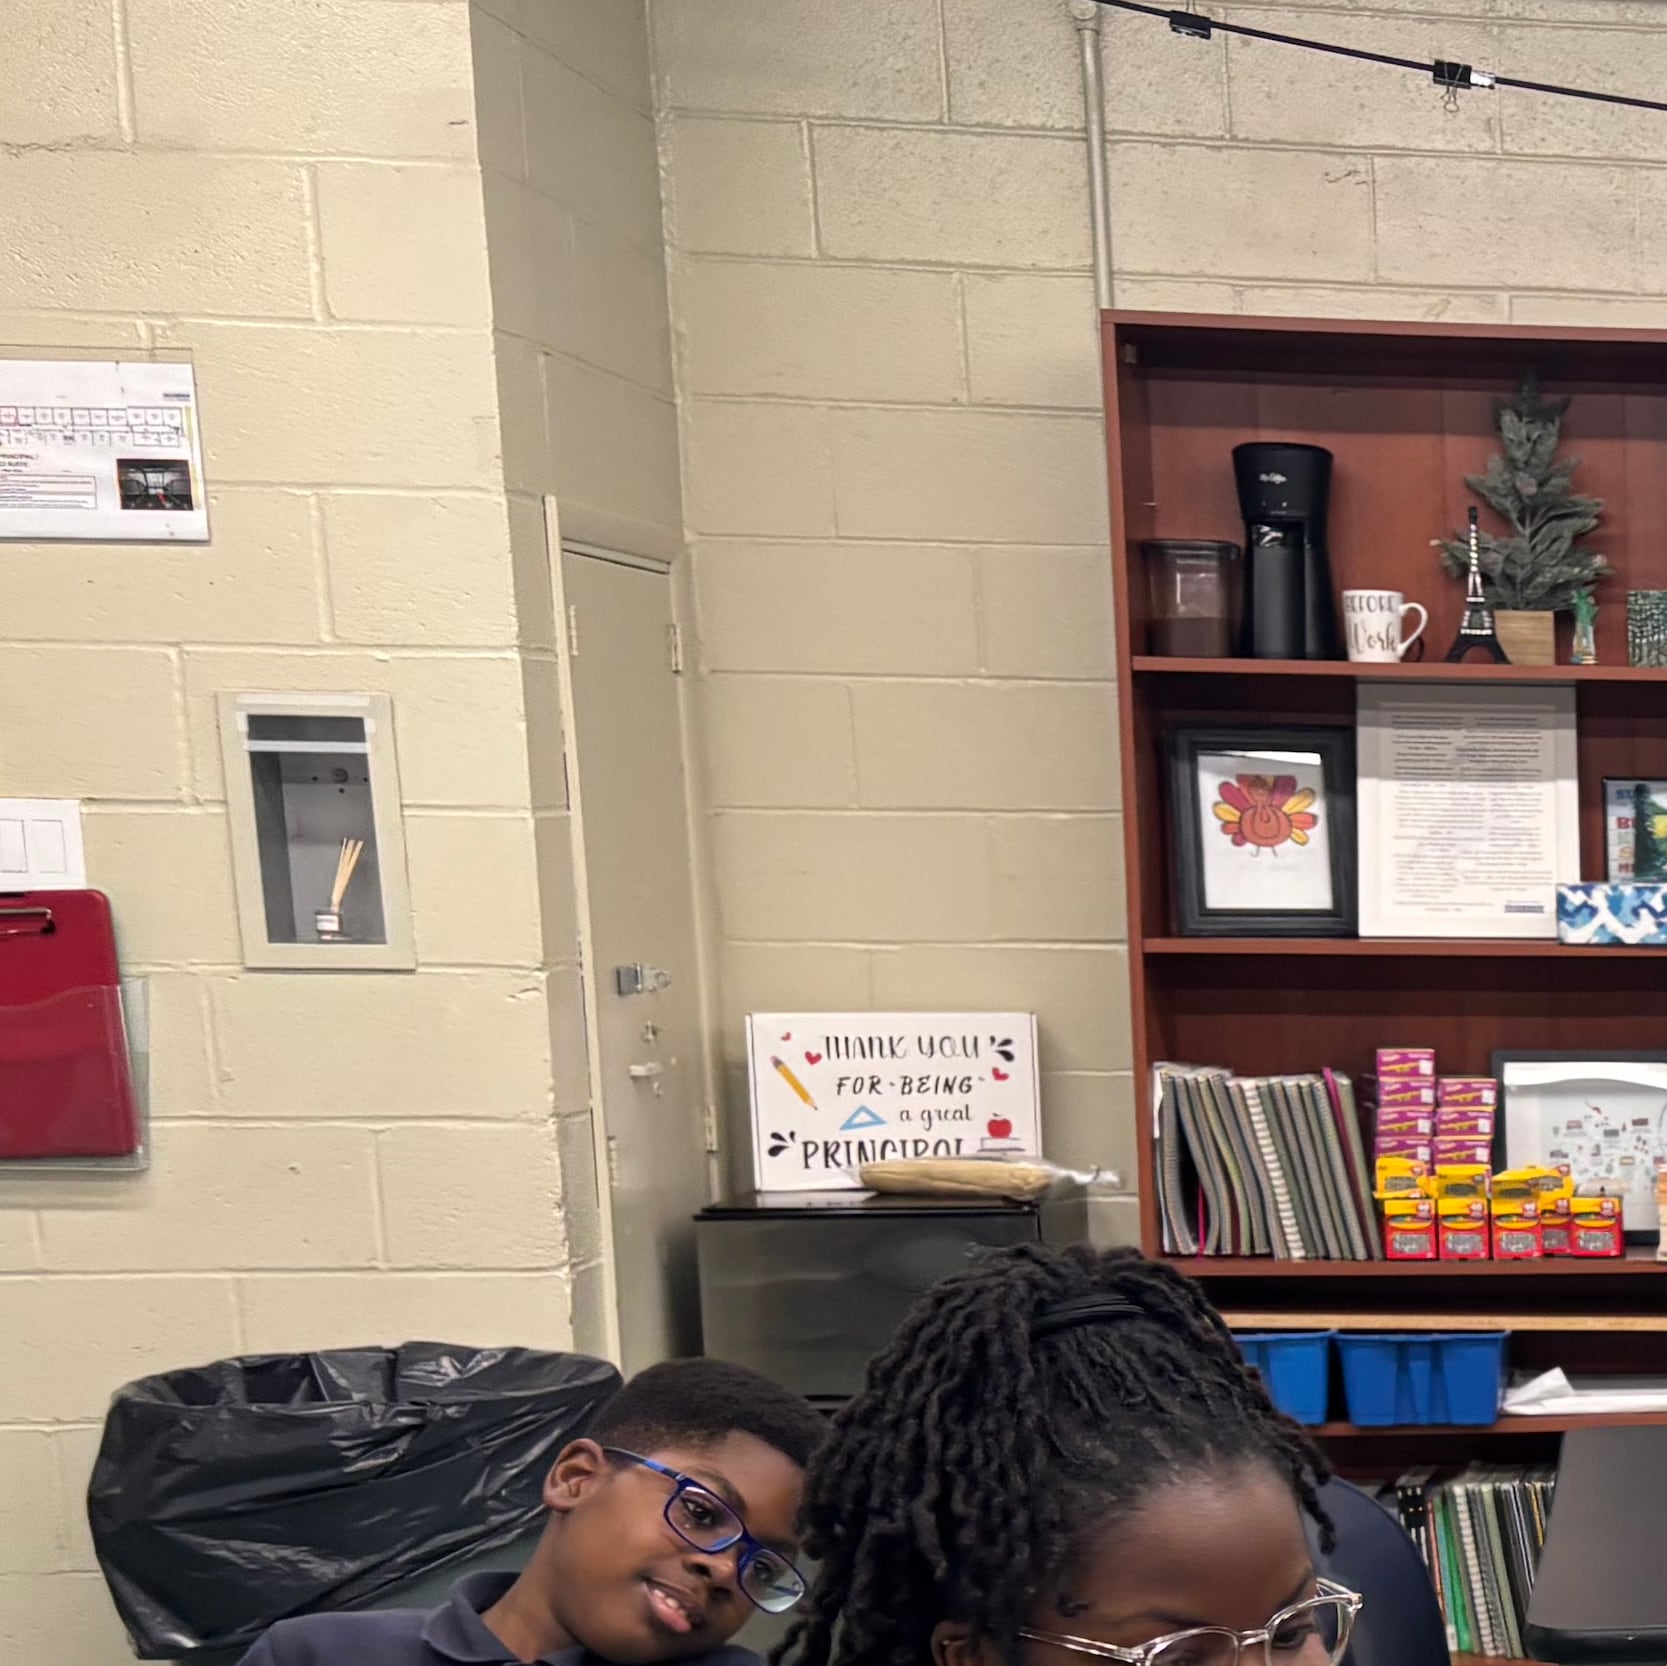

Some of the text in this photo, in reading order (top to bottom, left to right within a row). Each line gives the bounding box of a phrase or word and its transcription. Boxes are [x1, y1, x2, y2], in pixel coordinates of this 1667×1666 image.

[1345, 595, 1395, 613] BEFORE
[824, 1034, 980, 1061] THANK YOU
[836, 1075, 883, 1096] FOR
[900, 1103, 974, 1131] a great
